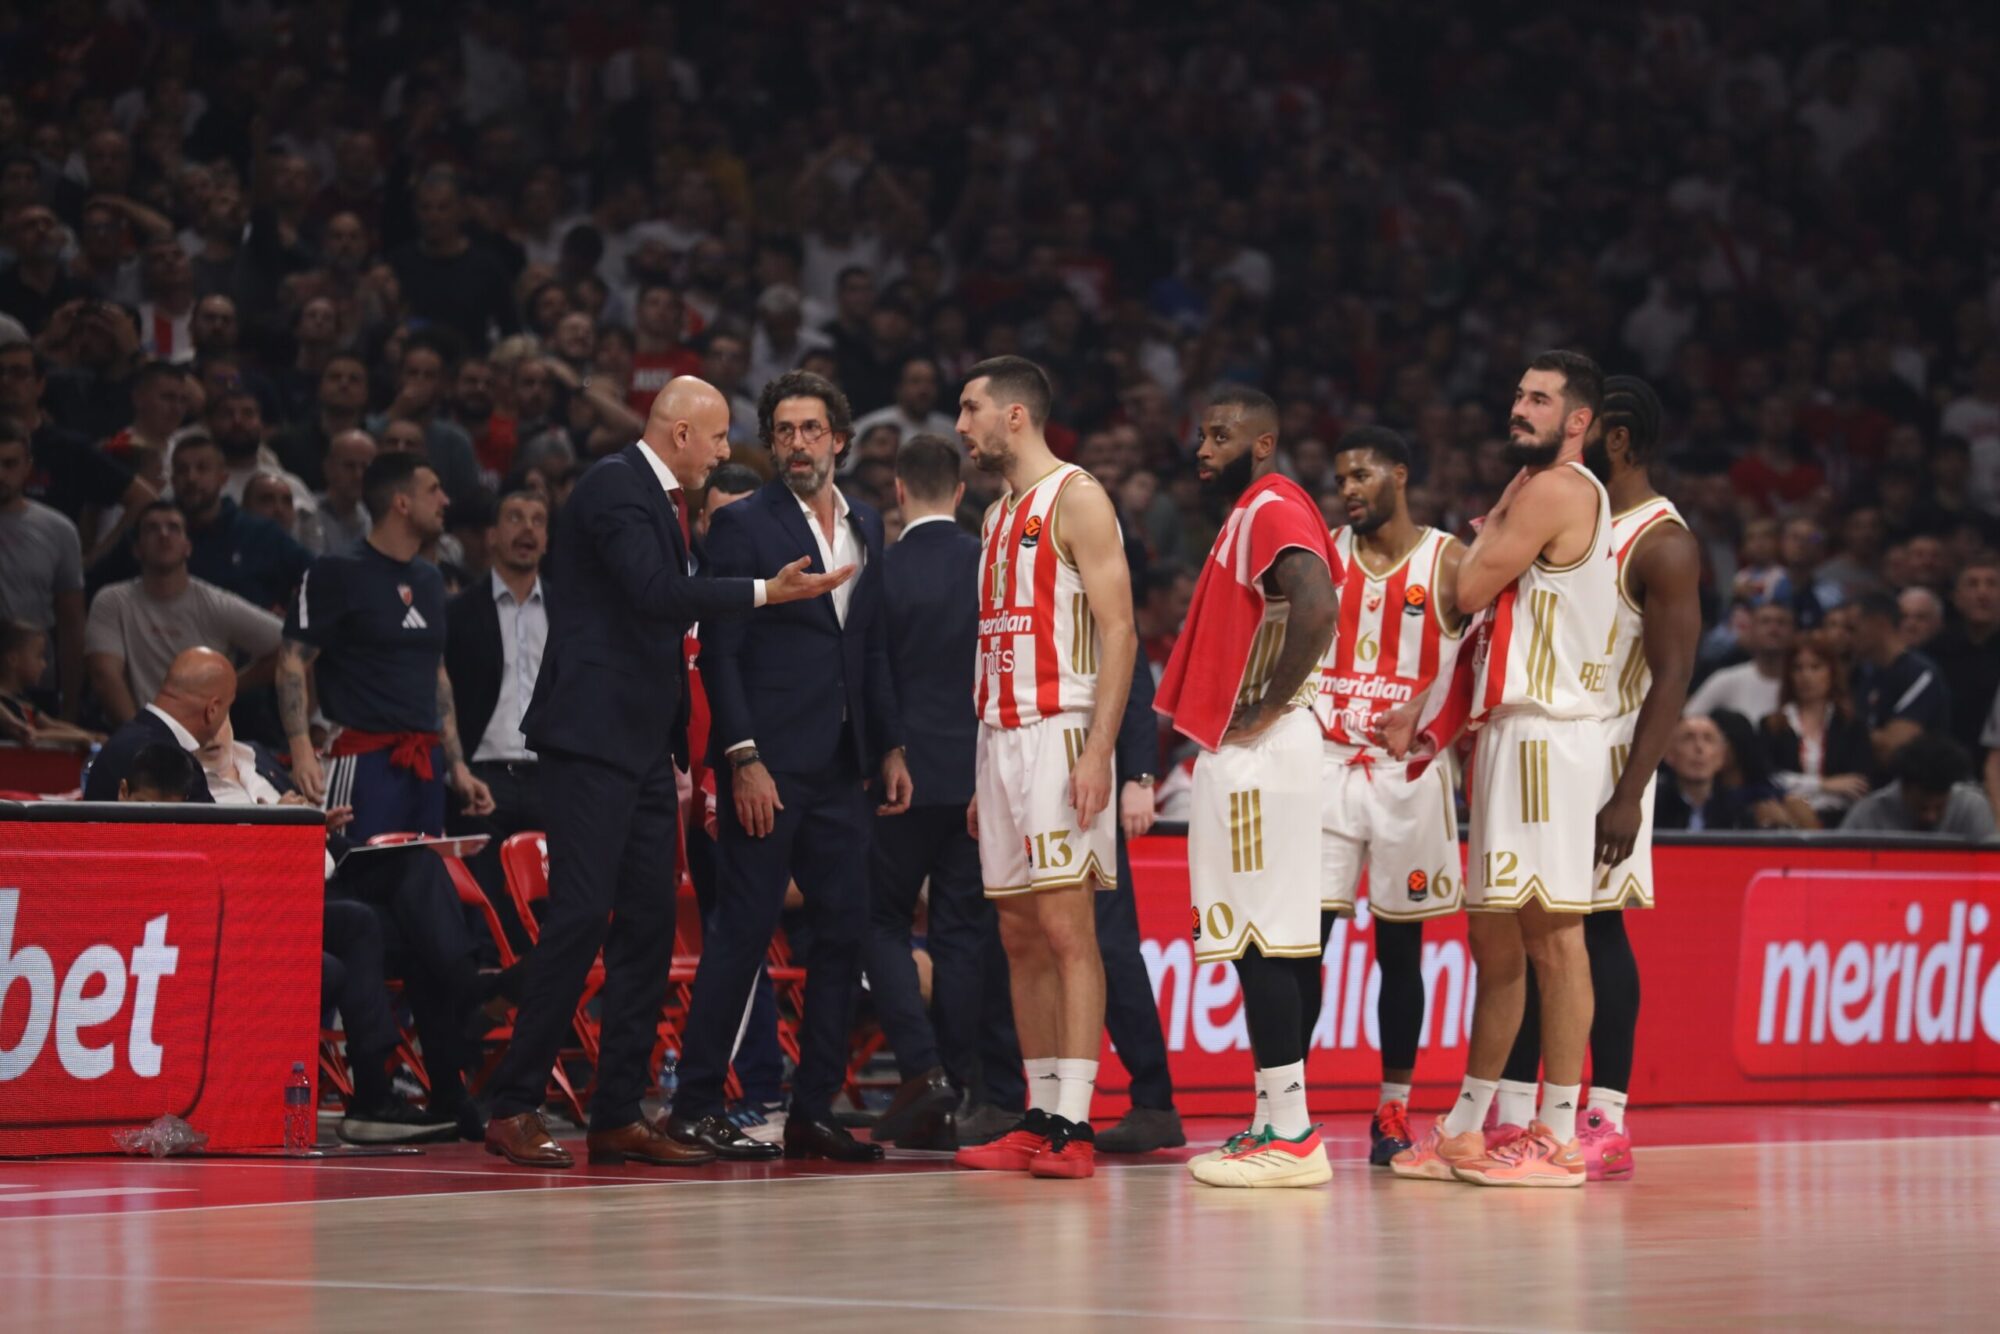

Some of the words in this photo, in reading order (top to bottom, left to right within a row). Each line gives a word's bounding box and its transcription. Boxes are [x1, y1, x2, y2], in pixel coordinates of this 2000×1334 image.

[981, 644, 1015, 675] mts
[1357, 629, 1378, 662] 6
[1319, 674, 1412, 702] meridian
[1034, 830, 1073, 869] 13
[1432, 864, 1453, 899] 6
[1483, 851, 1518, 888] 12
[1206, 902, 1234, 940] 0
[1757, 900, 2000, 1046] meridi
